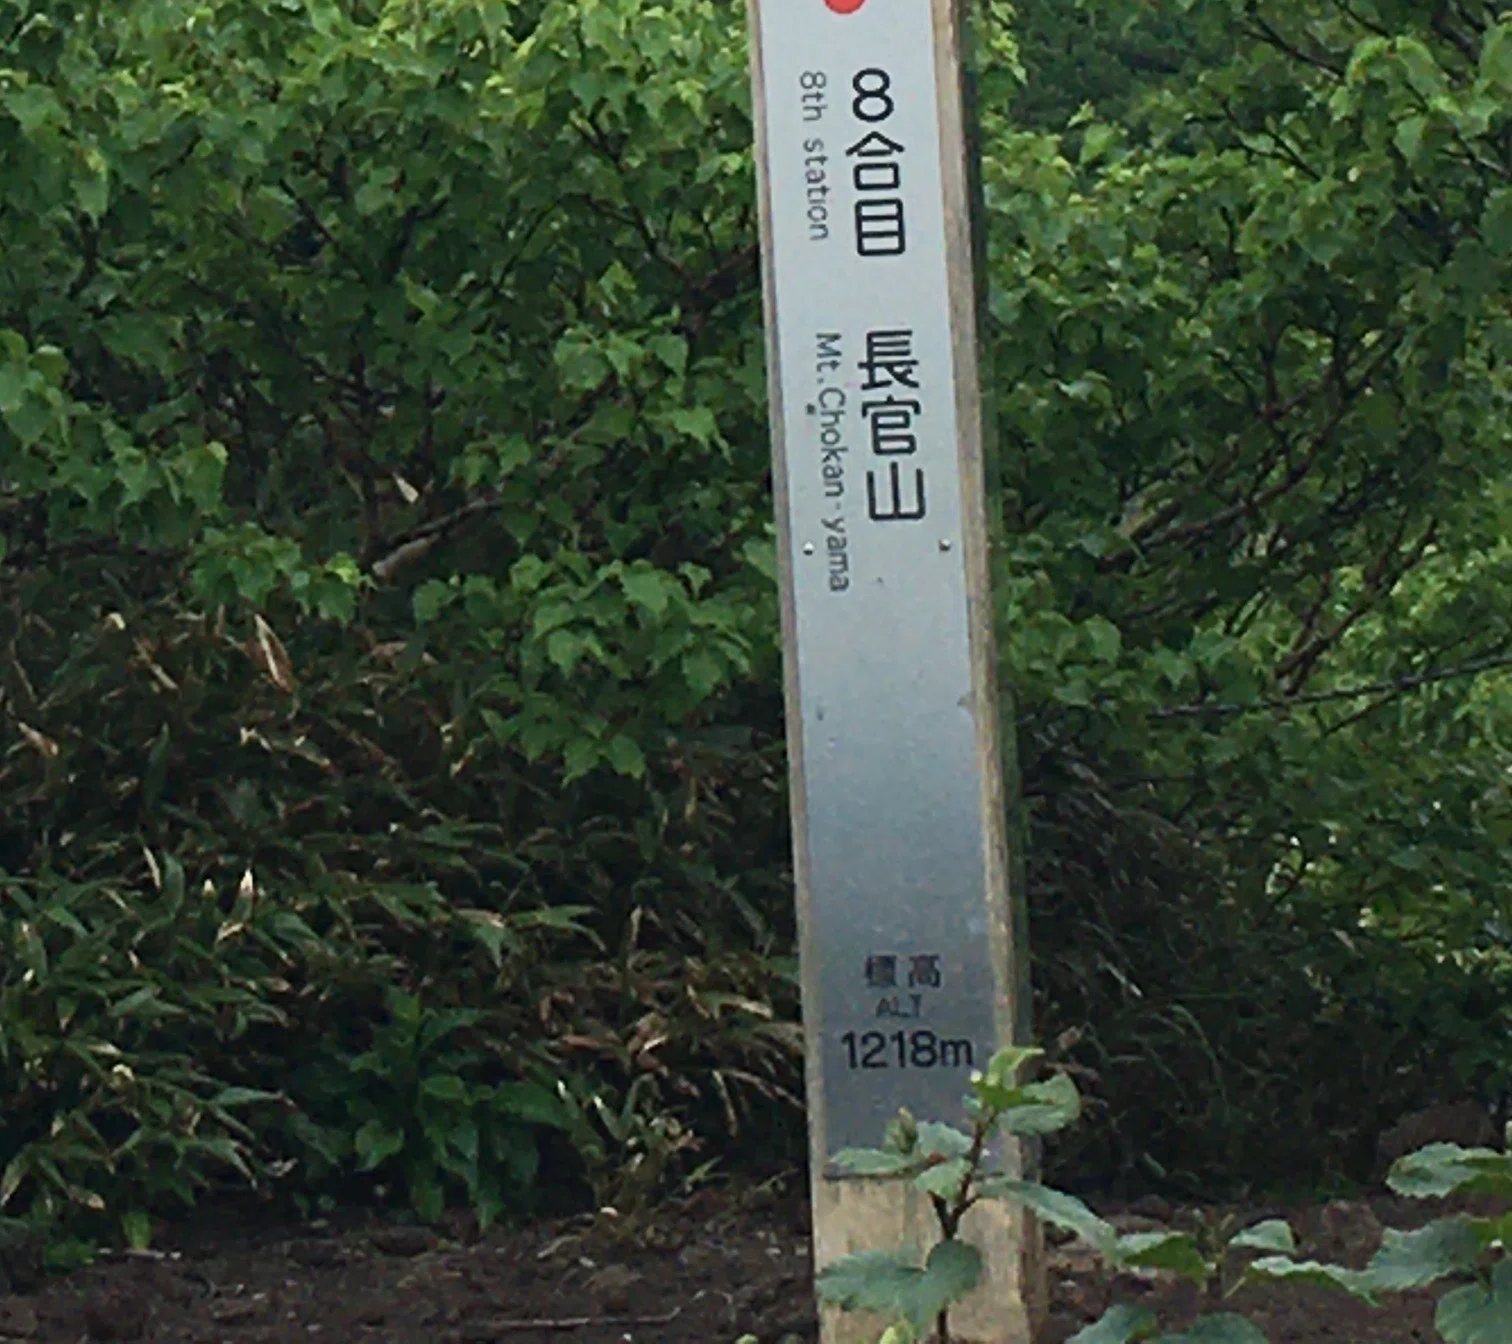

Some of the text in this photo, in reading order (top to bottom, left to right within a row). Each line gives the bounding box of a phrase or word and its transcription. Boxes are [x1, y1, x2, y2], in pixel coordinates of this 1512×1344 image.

[799, 70, 829, 122] 8th
[802, 136, 832, 242] station
[845, 67, 927, 522] 8合目 長官山
[840, 1029, 974, 1070] 1218m
